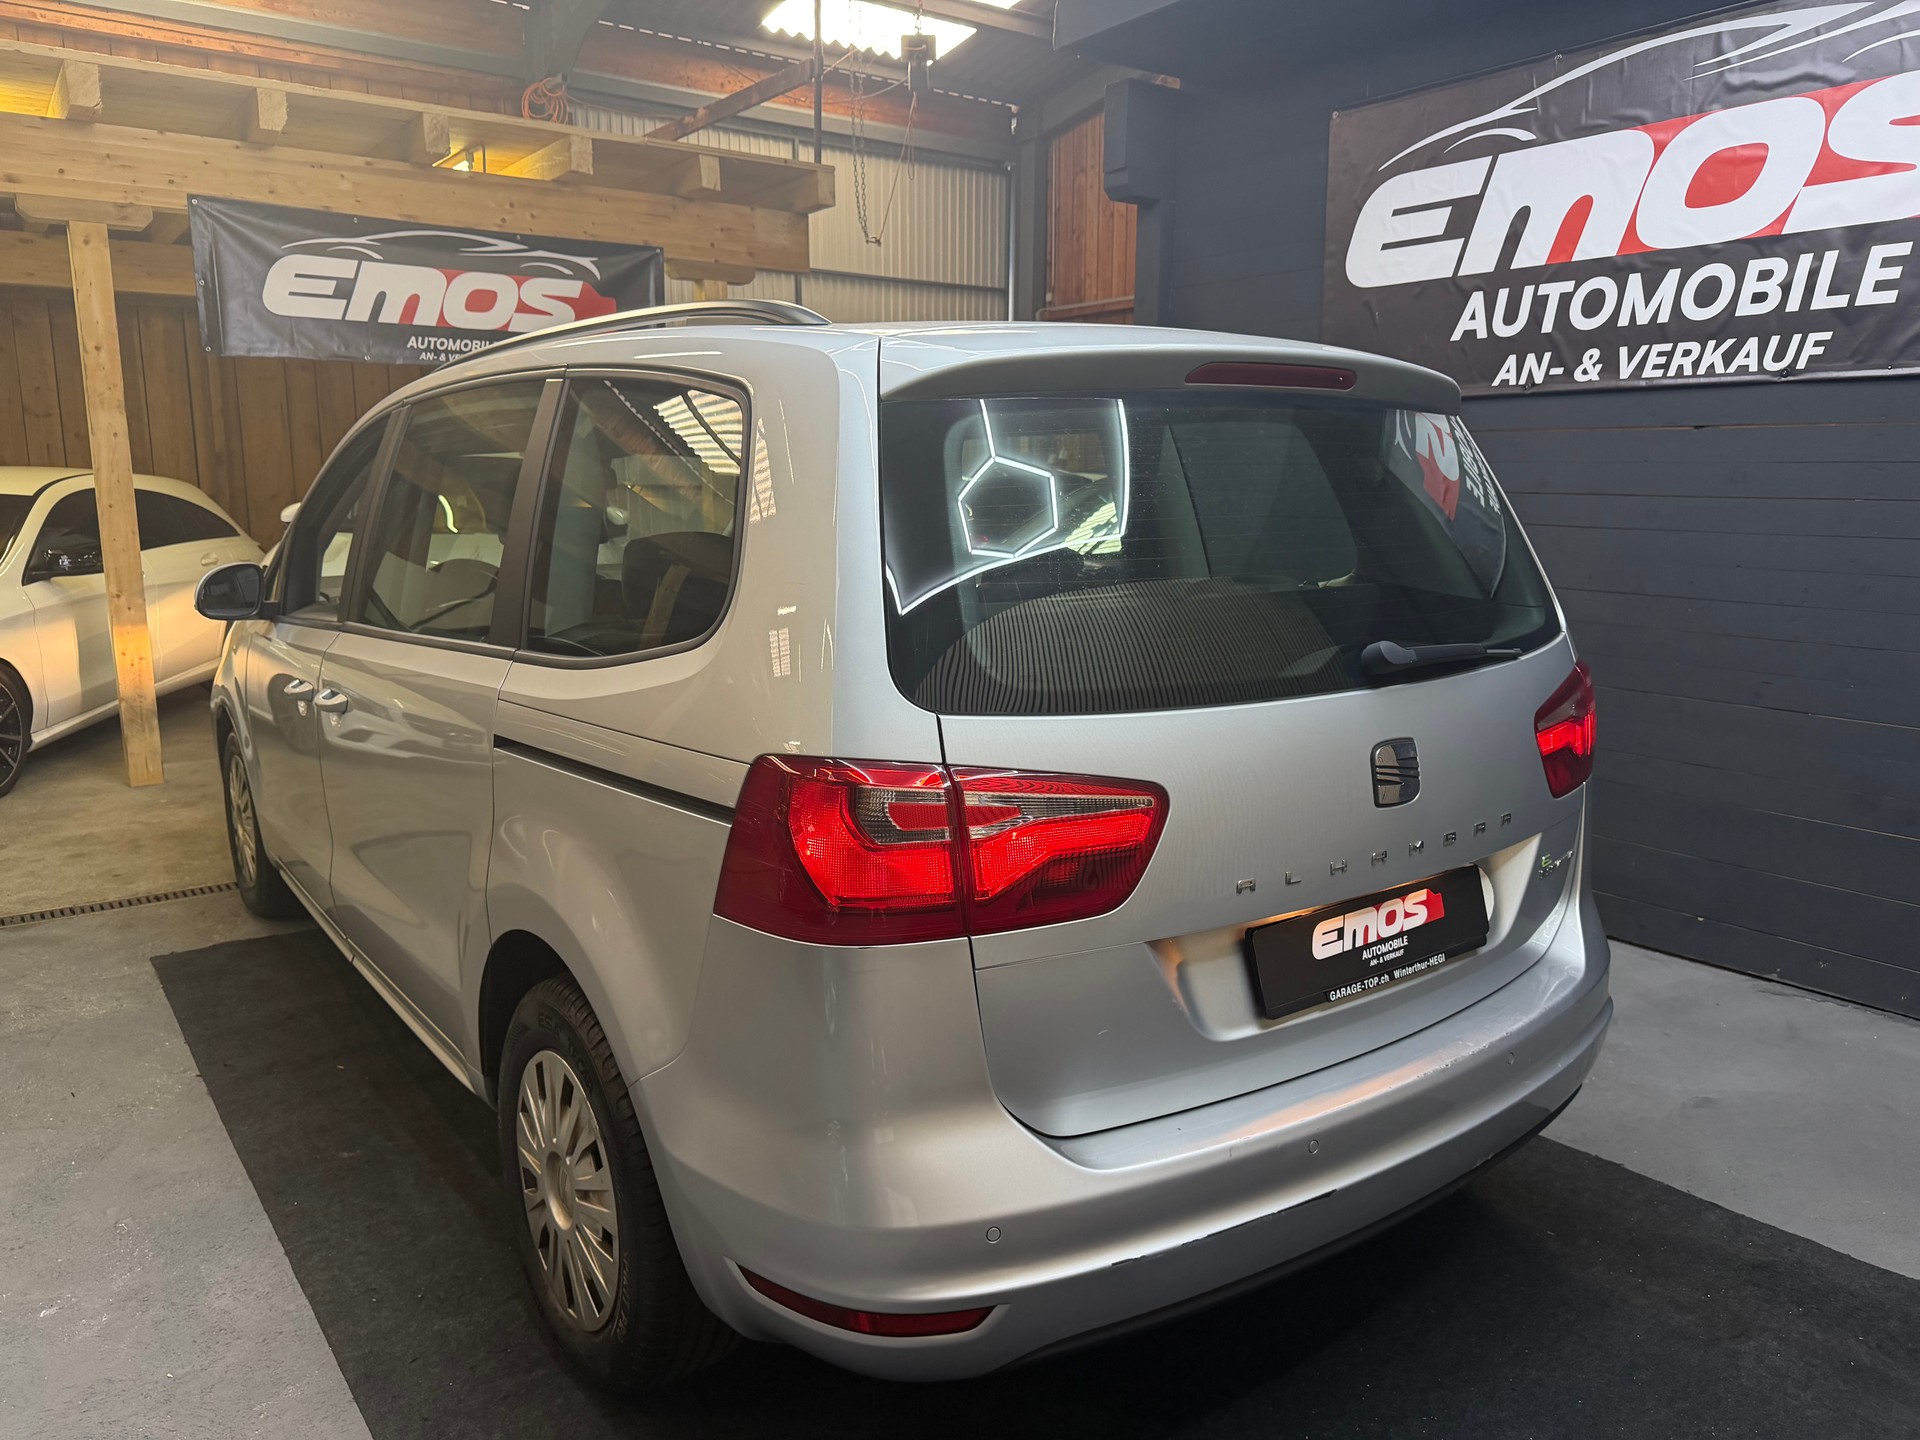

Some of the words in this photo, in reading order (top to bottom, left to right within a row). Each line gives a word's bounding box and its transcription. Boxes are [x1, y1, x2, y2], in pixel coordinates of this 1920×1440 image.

[1450, 241, 1913, 342] AUTOMOBILE
[419, 351, 438, 361] AN-
[439, 352, 446, 362] &
[1491, 353, 1565, 387] AN-
[1573, 347, 1604, 382] &
[1618, 331, 1834, 380] VERKAUF
[1236, 812, 1512, 895] ALHAMBRA
[1362, 935, 1409, 960] AUTOMOBILE
[1383, 948, 1405, 963] VERKAUF
[1329, 973, 1390, 1001] GARAGE-TOP.ch
[1393, 953, 1446, 979] Winterthur-HEGI
